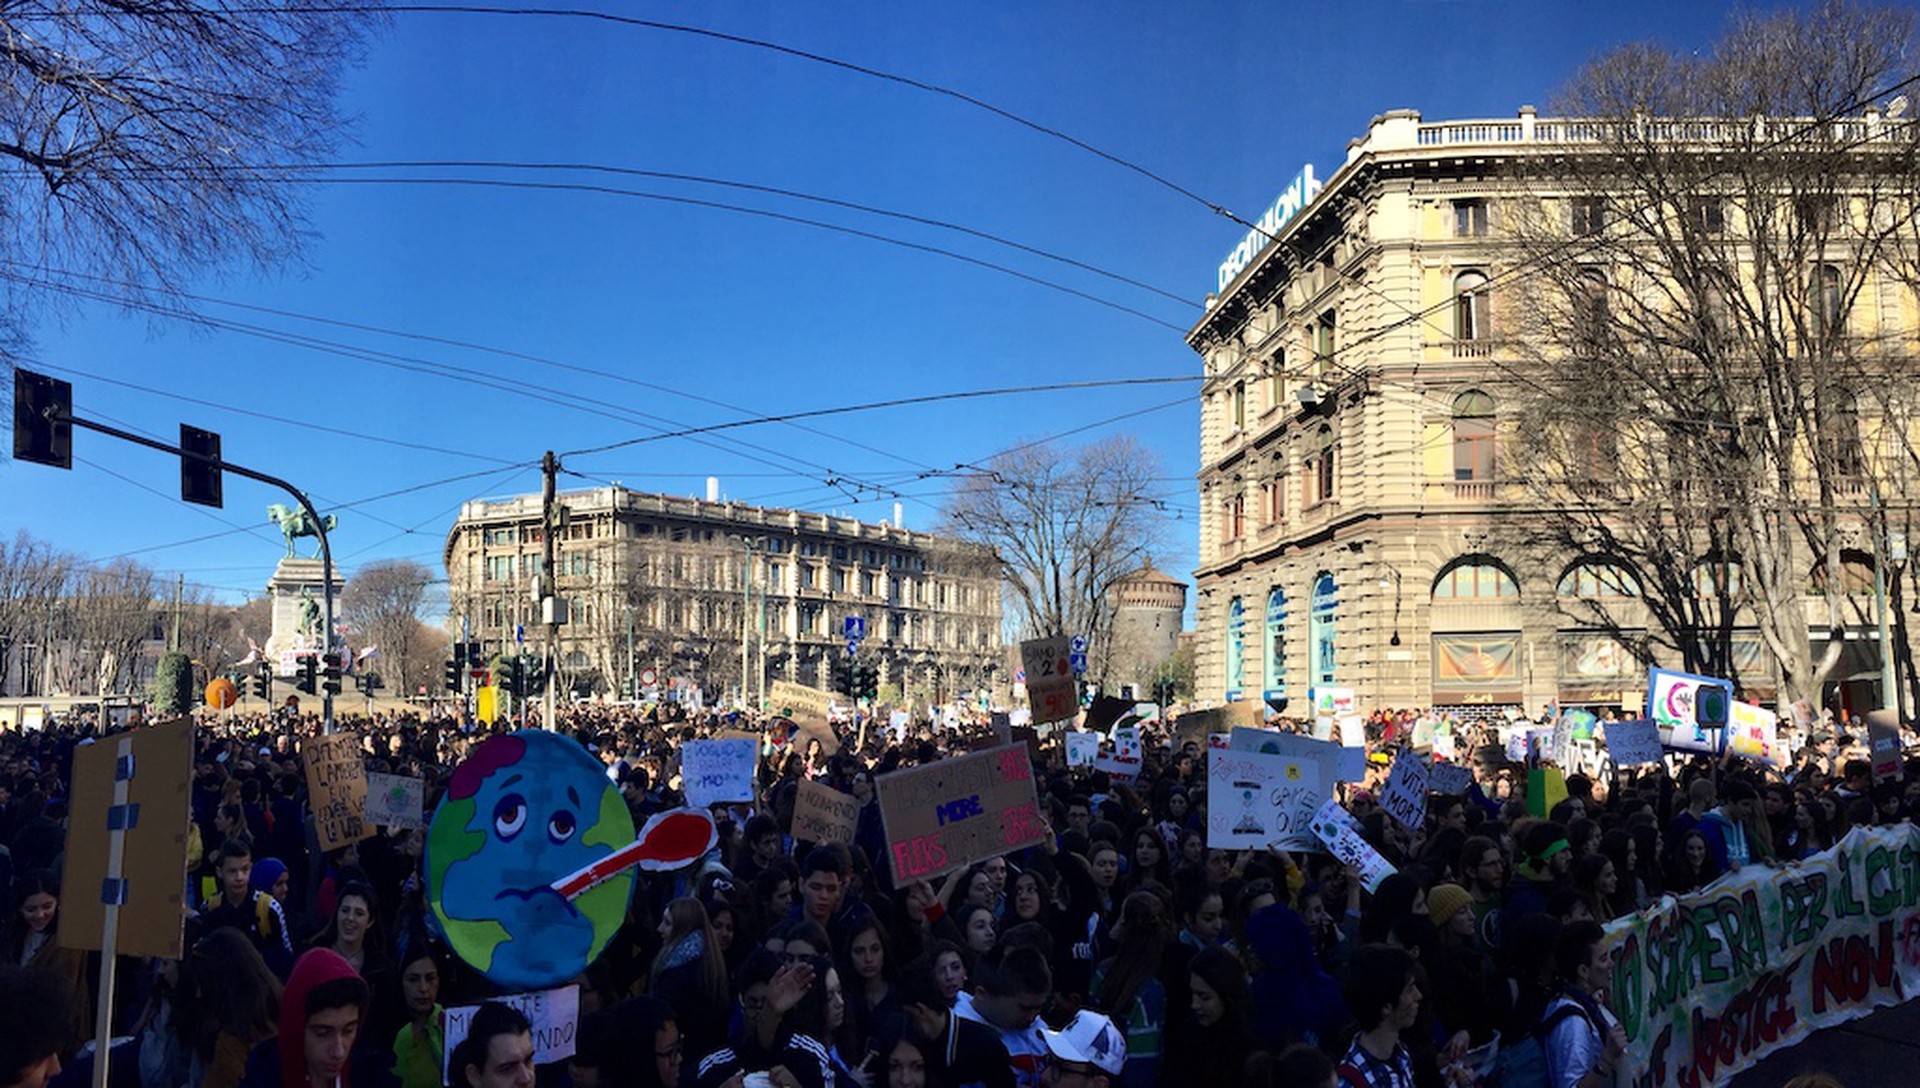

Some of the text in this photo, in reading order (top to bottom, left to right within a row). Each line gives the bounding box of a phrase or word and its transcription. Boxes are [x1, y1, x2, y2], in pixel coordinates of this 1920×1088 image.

[1218, 176, 1302, 293] DECATHLON
[935, 794, 985, 828] MORE
[1779, 872, 1830, 953] PER
